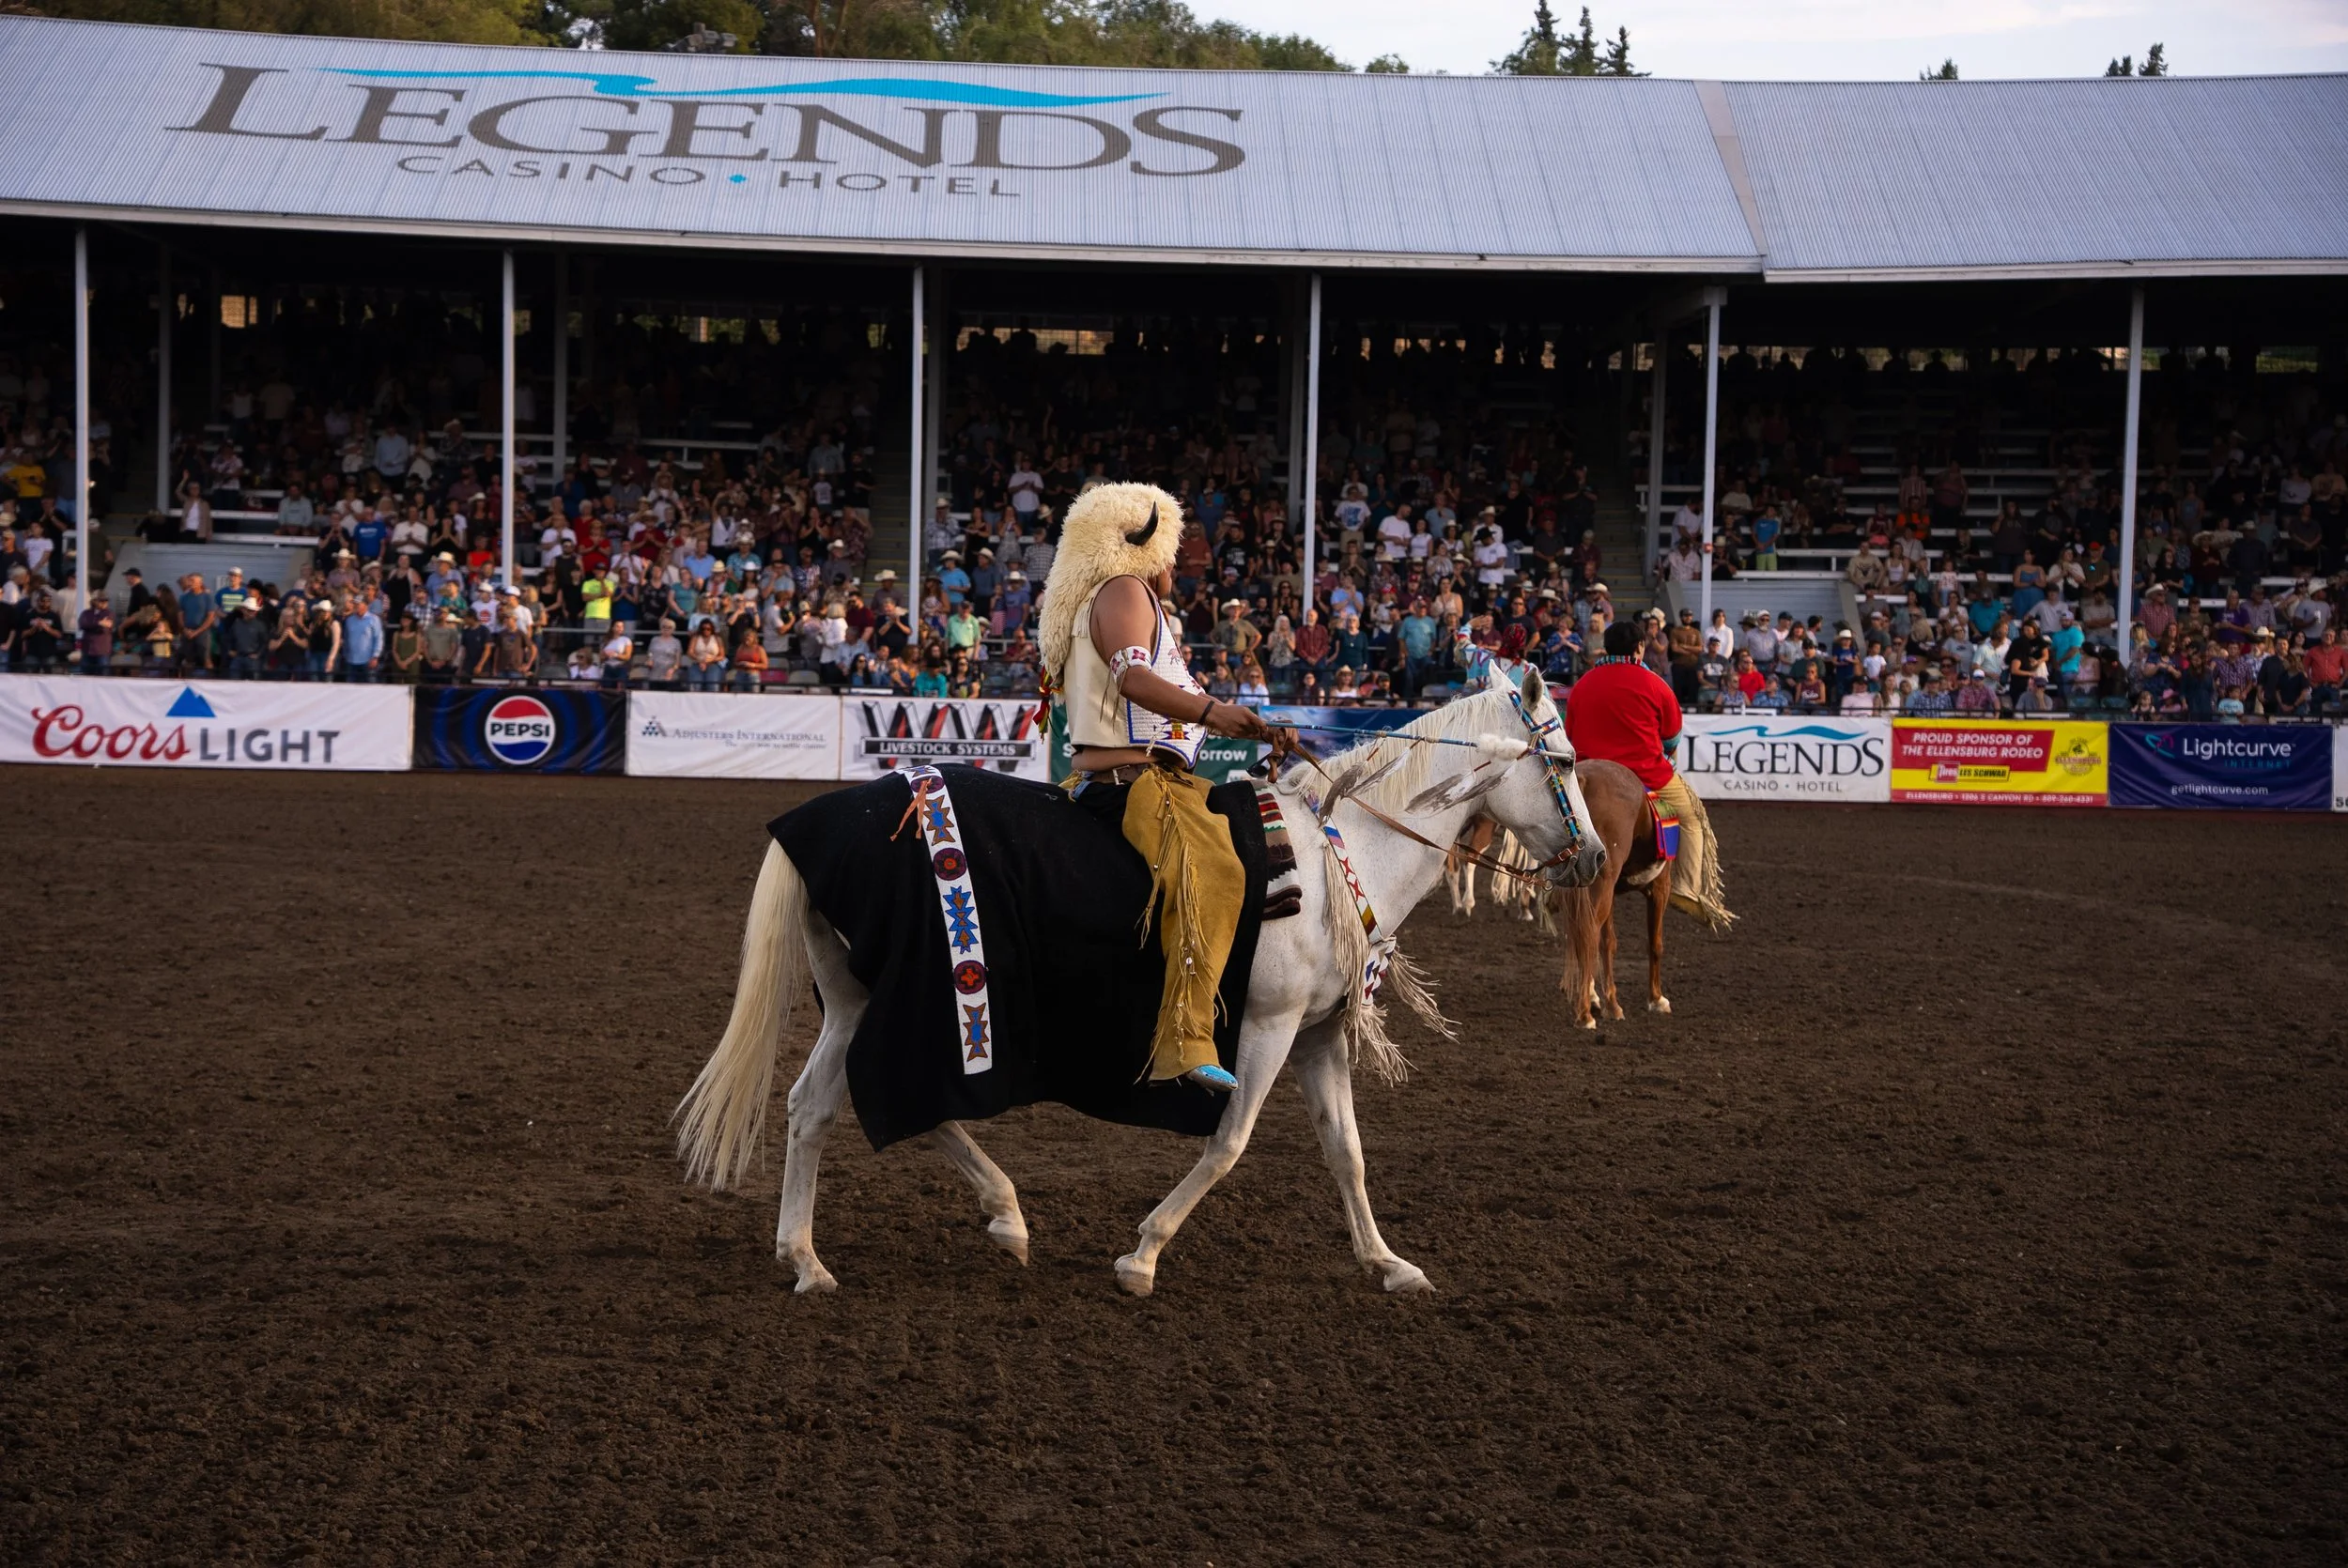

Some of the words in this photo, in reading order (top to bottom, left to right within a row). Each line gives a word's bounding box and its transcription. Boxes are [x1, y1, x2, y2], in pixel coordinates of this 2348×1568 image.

[163, 63, 1246, 177] LEGENDS
[396, 156, 706, 185] CASINO
[779, 171, 1021, 197] HOTEL
[31, 704, 191, 760] Coors
[199, 728, 341, 762] LIGHT
[490, 723, 550, 737] PEPSI
[672, 729, 734, 740] ADJUSTERS
[736, 730, 826, 742] INTERNATIONAL
[1913, 732, 1953, 744] PROUD
[1956, 733, 2013, 745] SPONSOR
[2016, 734, 2033, 745] OF
[879, 743, 951, 755] LIVESTOCK
[957, 744, 1016, 756] SYSTEMS
[1683, 735, 1885, 776] LEGENDS
[1902, 745, 1924, 756] THE
[1927, 746, 1998, 758] ELLENSBURG
[2001, 747, 2043, 759] RODEO
[2184, 738, 2292, 760] Lightcurve
[2224, 760, 2291, 768] INTERNET
[1723, 780, 1779, 792] CASINO
[1797, 781, 1842, 792] HOTEL
[2171, 784, 2269, 795] getlightcurve.com
[1906, 792, 1954, 800] ELLENSBURG
[1987, 793, 2021, 802] CANYON
